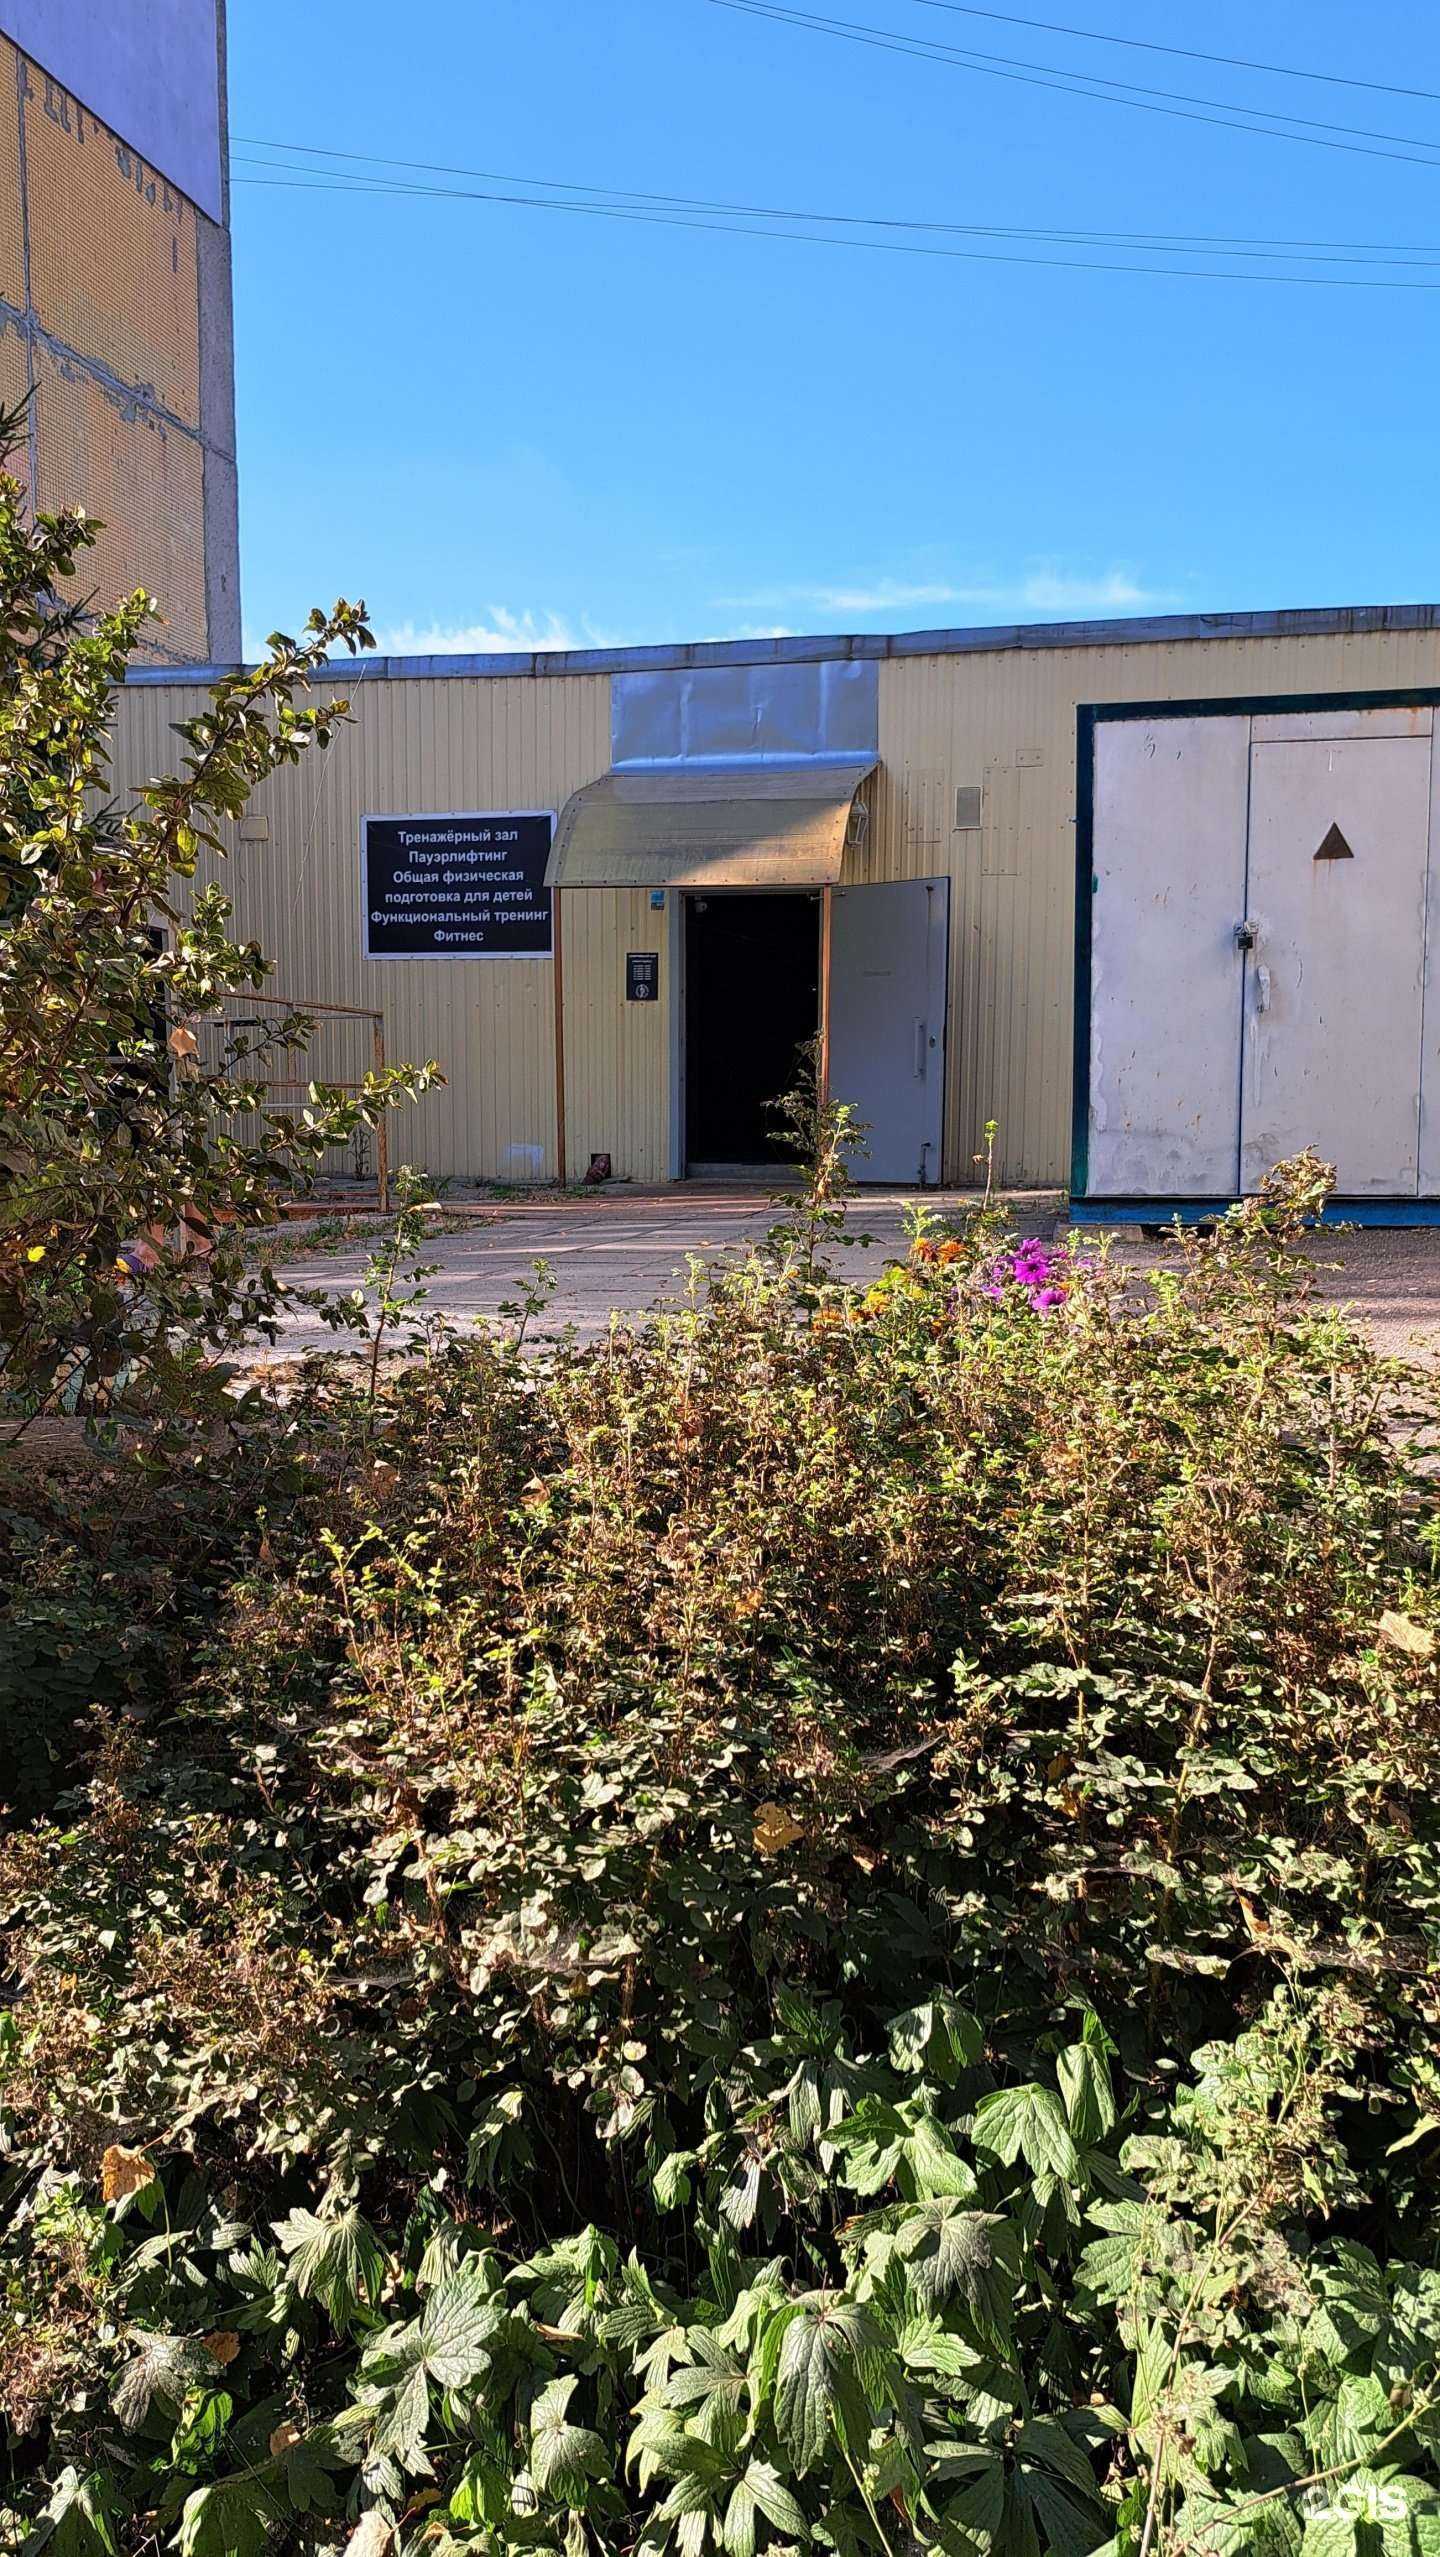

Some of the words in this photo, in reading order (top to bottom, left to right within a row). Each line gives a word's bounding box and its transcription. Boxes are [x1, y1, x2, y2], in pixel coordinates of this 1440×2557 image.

[398, 829, 491, 846] Тренажёрный
[495, 830, 518, 841] зал
[409, 850, 508, 865] Пауэрлифтинг
[393, 871, 439, 884] Общая
[443, 871, 524, 884] физическая
[385, 892, 461, 904] подготовка
[464, 892, 490, 903] для
[493, 889, 533, 902] детей
[371, 910, 491, 925] Функциональный
[494, 911, 549, 924] тренинг
[434, 930, 484, 942] Фитнес
